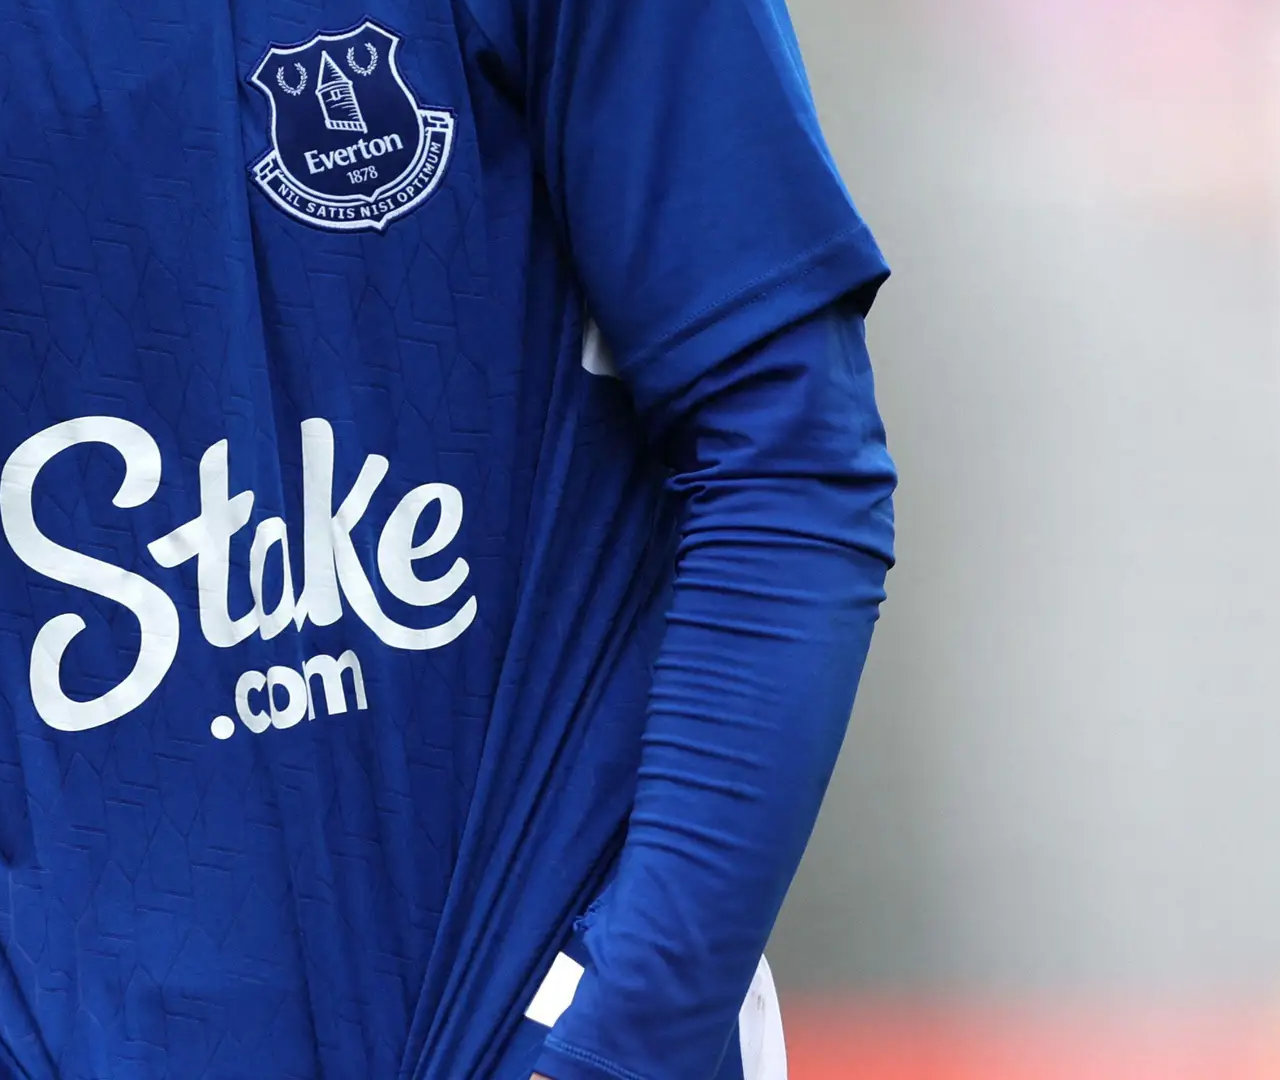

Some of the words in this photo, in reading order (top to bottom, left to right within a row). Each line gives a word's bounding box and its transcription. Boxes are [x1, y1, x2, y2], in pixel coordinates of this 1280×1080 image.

[278, 183, 300, 207] NIL
[306, 202, 355, 219] SATIS
[360, 201, 395, 216] NISI
[396, 142, 442, 203] OPTIMUM
[304, 133, 404, 174] Everton
[346, 165, 378, 185] 1878
[0, 415, 477, 732] Stake
[210, 649, 368, 740] .com
